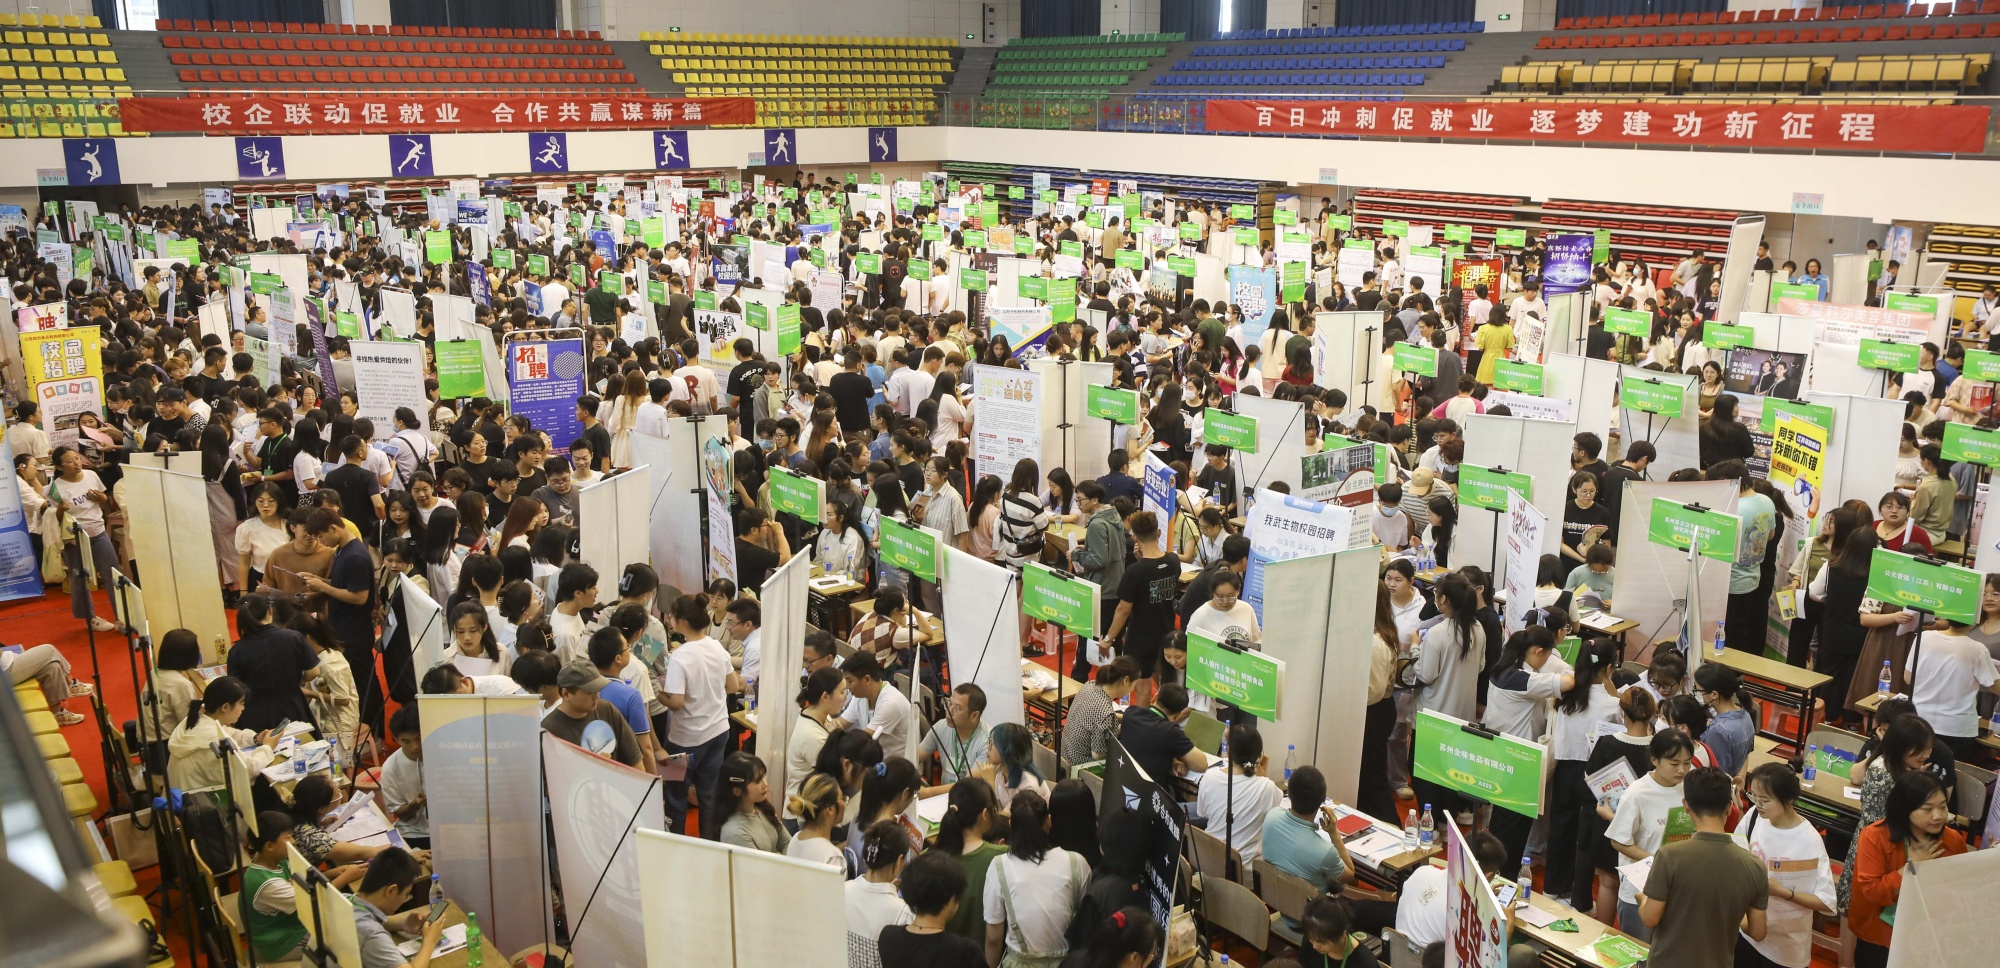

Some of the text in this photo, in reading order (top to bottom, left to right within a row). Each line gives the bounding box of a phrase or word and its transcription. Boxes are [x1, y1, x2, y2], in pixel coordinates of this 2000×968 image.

[202, 101, 702, 126] 校企联动促就业 合作共赢谋新篇
[1255, 105, 1875, 142] 百日冲刺促就业 逐梦建功新征程
[1795, 202, 1819, 210] 安全出口
[1460, 263, 1497, 289] 招聘
[1235, 282, 1263, 299] 校园
[40, 339, 84, 360] 校园
[43, 357, 87, 380] 招聘
[740, 368, 757, 381] WORLD
[979, 377, 1004, 388] JOIN
[980, 387, 993, 397] US
[1778, 426, 1796, 443] 同学
[1264, 514, 1336, 541] 我武生物校园招聘
[1664, 516, 1721, 536] 苏州苏大卫生环境技术
[1673, 525, 1710, 540] 研究所有公司
[1884, 569, 1963, 595] 公元管道（江苏）有限公司
[1214, 671, 1247, 690] 有限责任公司
[1453, 771, 1471, 782] 座位号
